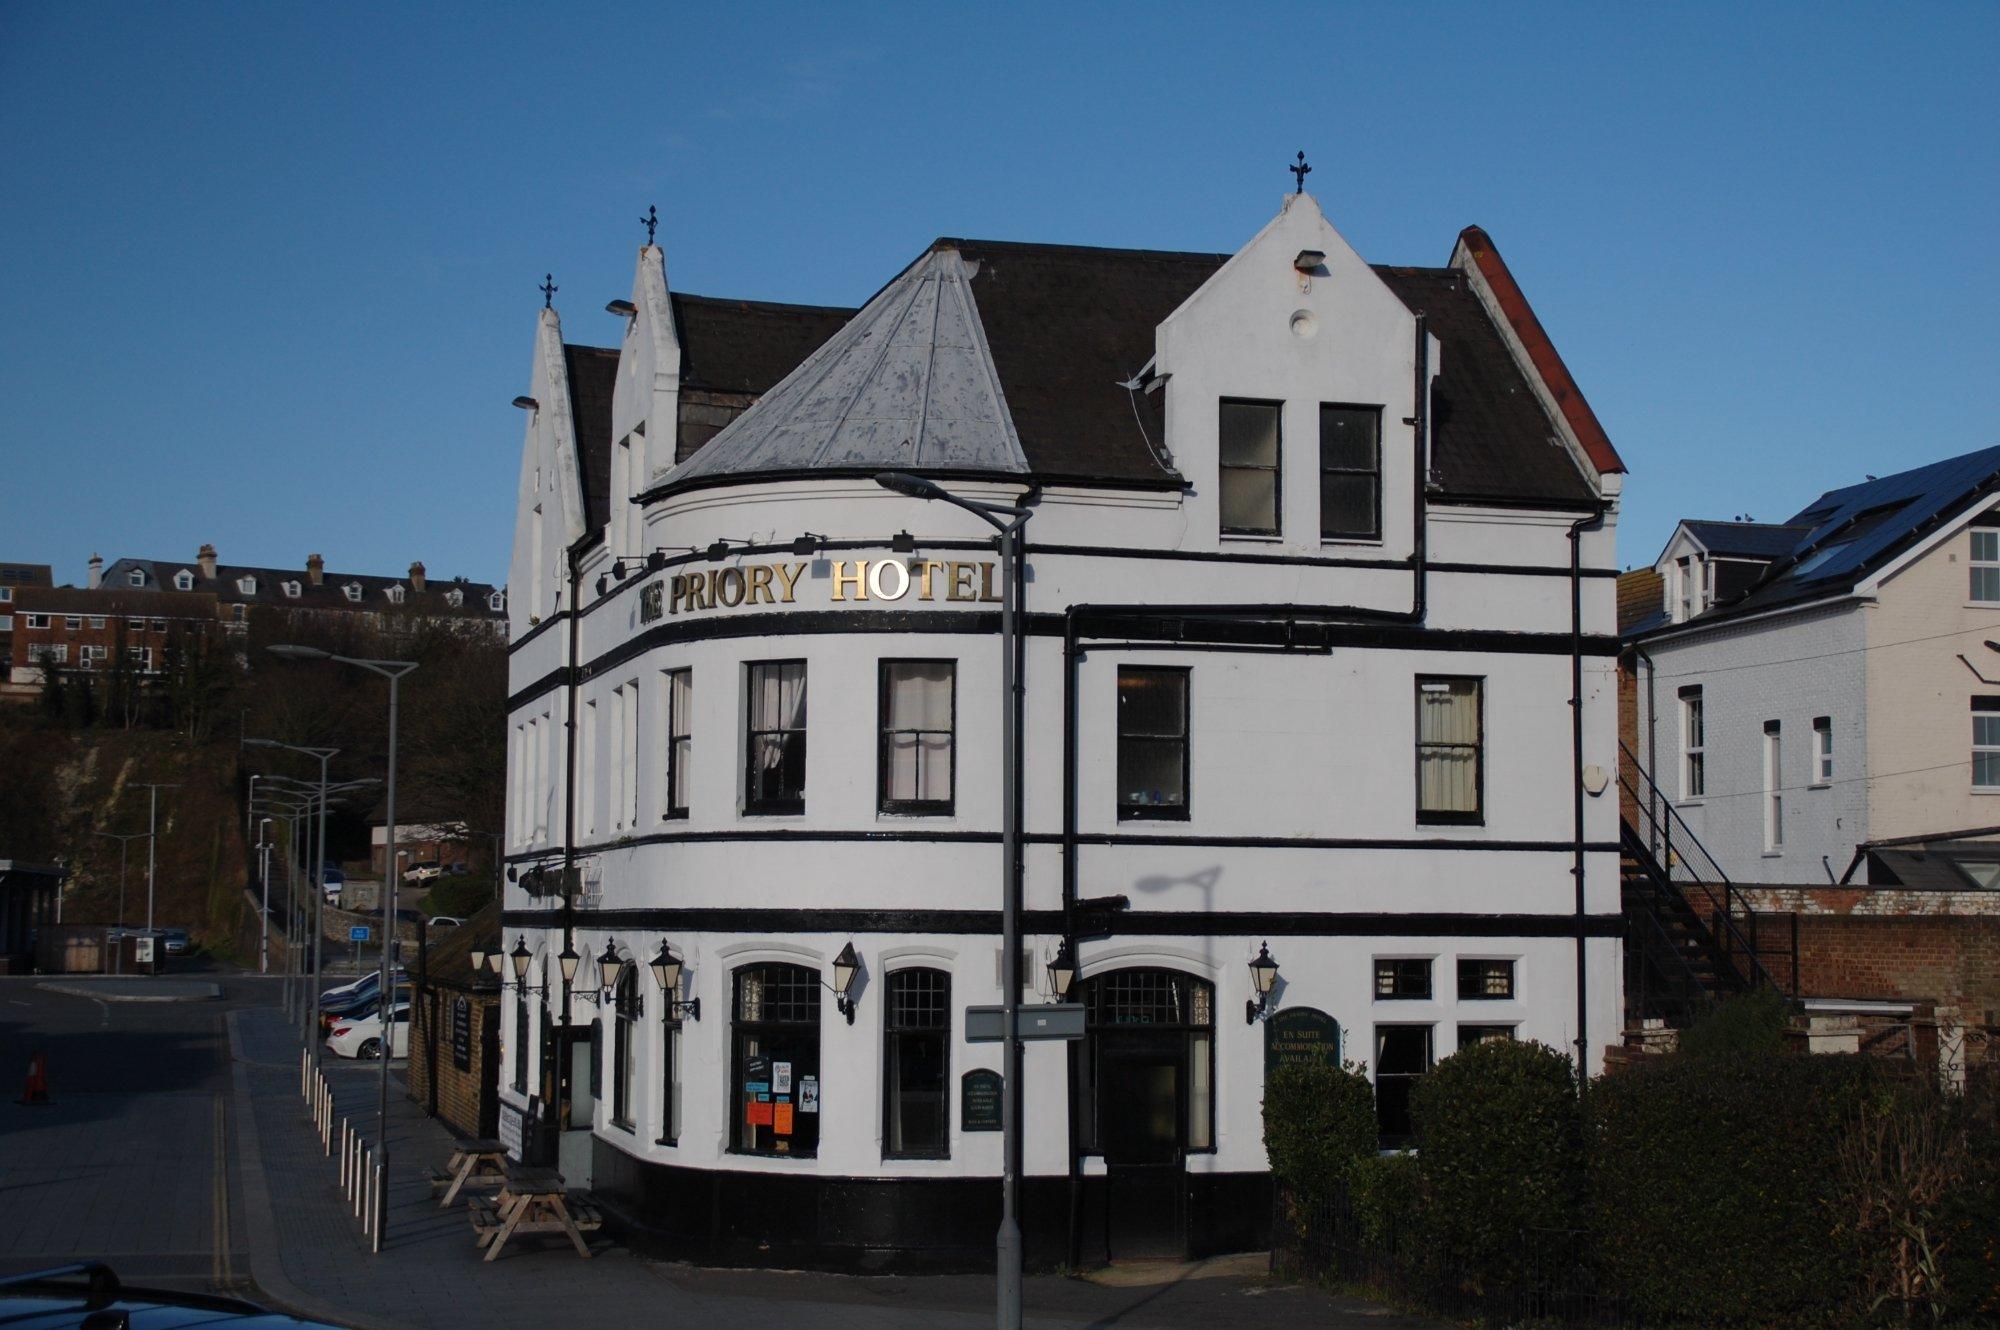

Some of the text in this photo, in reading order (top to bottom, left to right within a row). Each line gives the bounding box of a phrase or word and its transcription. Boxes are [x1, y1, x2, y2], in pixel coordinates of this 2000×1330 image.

[669, 562, 807, 614] PRIORY
[831, 559, 1003, 602] HOTEL
[1283, 1031, 1320, 1039] EN SUITE
[1271, 1042, 1335, 1051] ACCOMMODION
